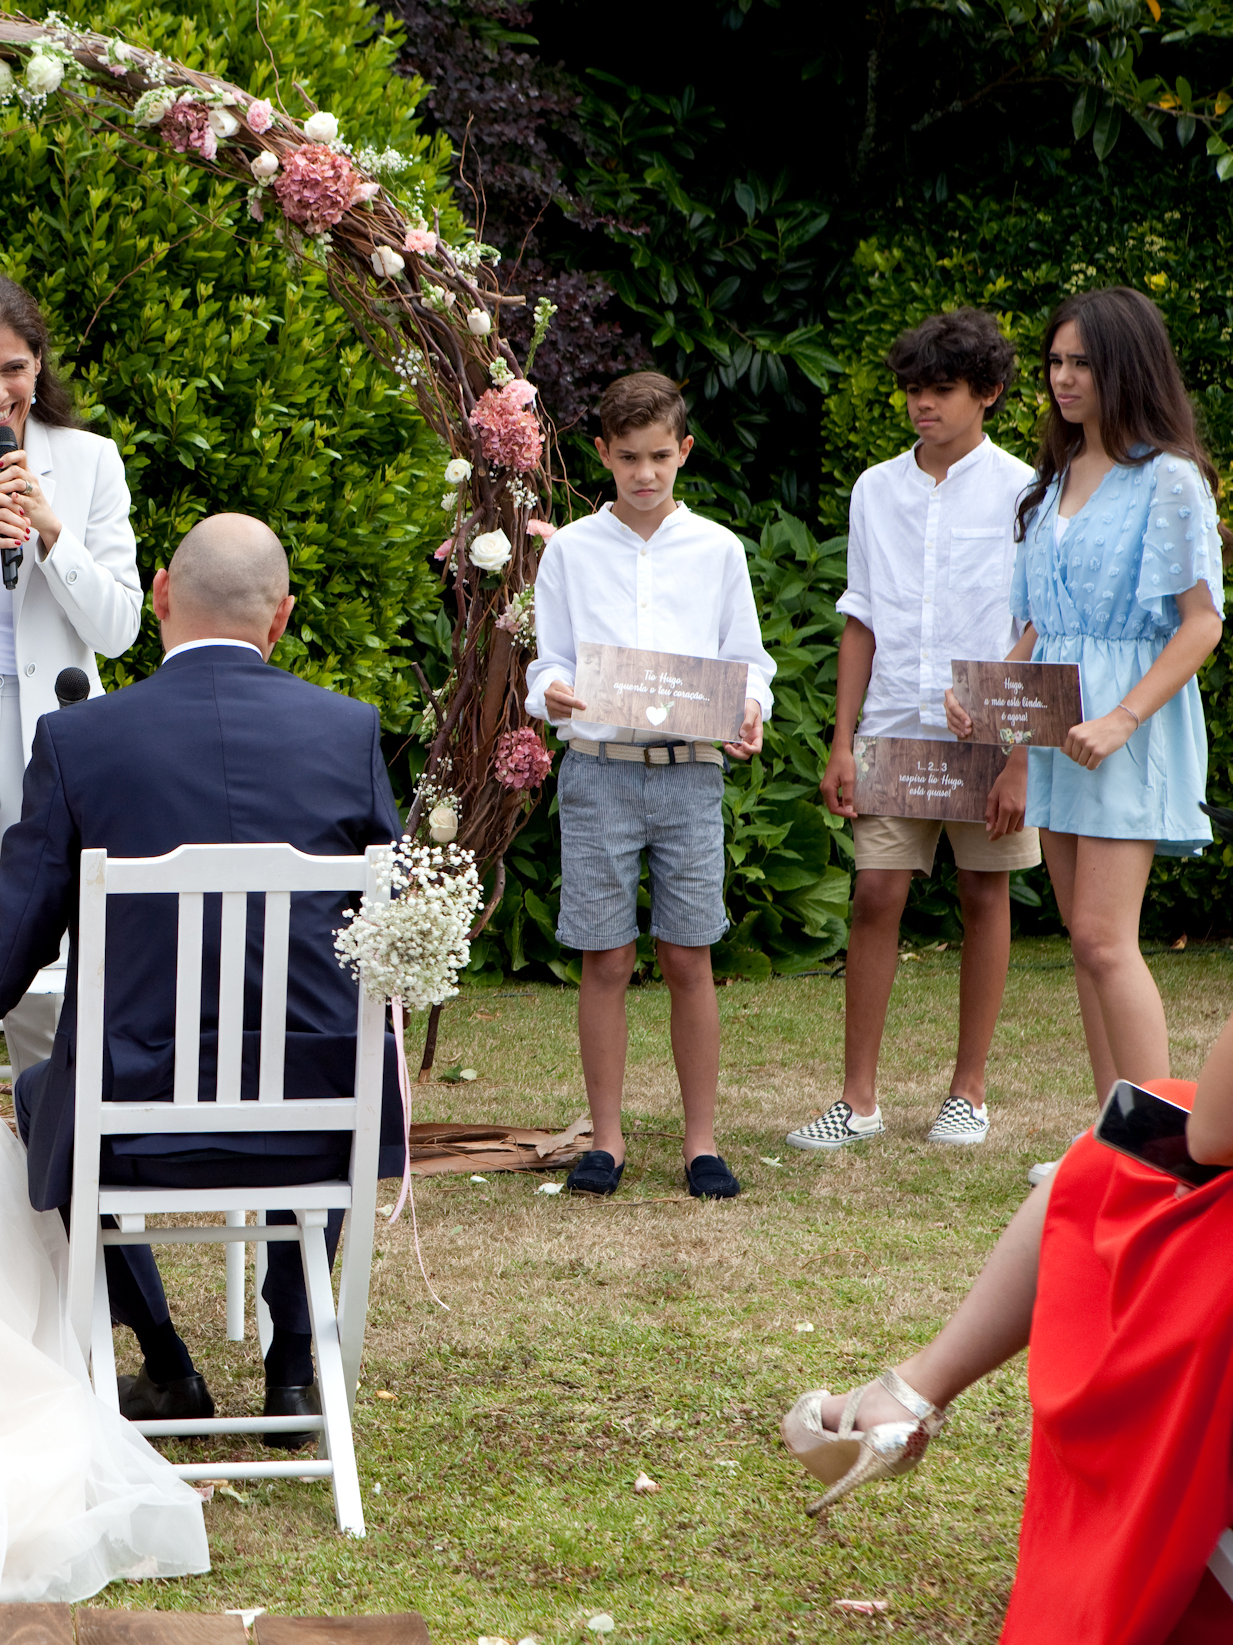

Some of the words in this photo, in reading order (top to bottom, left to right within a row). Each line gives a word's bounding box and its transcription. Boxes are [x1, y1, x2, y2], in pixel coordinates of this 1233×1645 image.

[644, 670, 657, 681] Tio
[659, 672, 683, 689] Hugo,
[1004, 677, 1024, 695] Hugo,
[613, 682, 648, 694] aguenta
[658, 685, 672, 696] teu
[1007, 696, 1021, 707] está
[1007, 712, 1028, 727] agora!
[941, 763, 947, 772] 3
[899, 774, 926, 787] respira
[928, 773, 939, 783] tio
[941, 774, 964, 790] Hugo,
[909, 786, 925, 795] está
[927, 789, 951, 801] quase!
